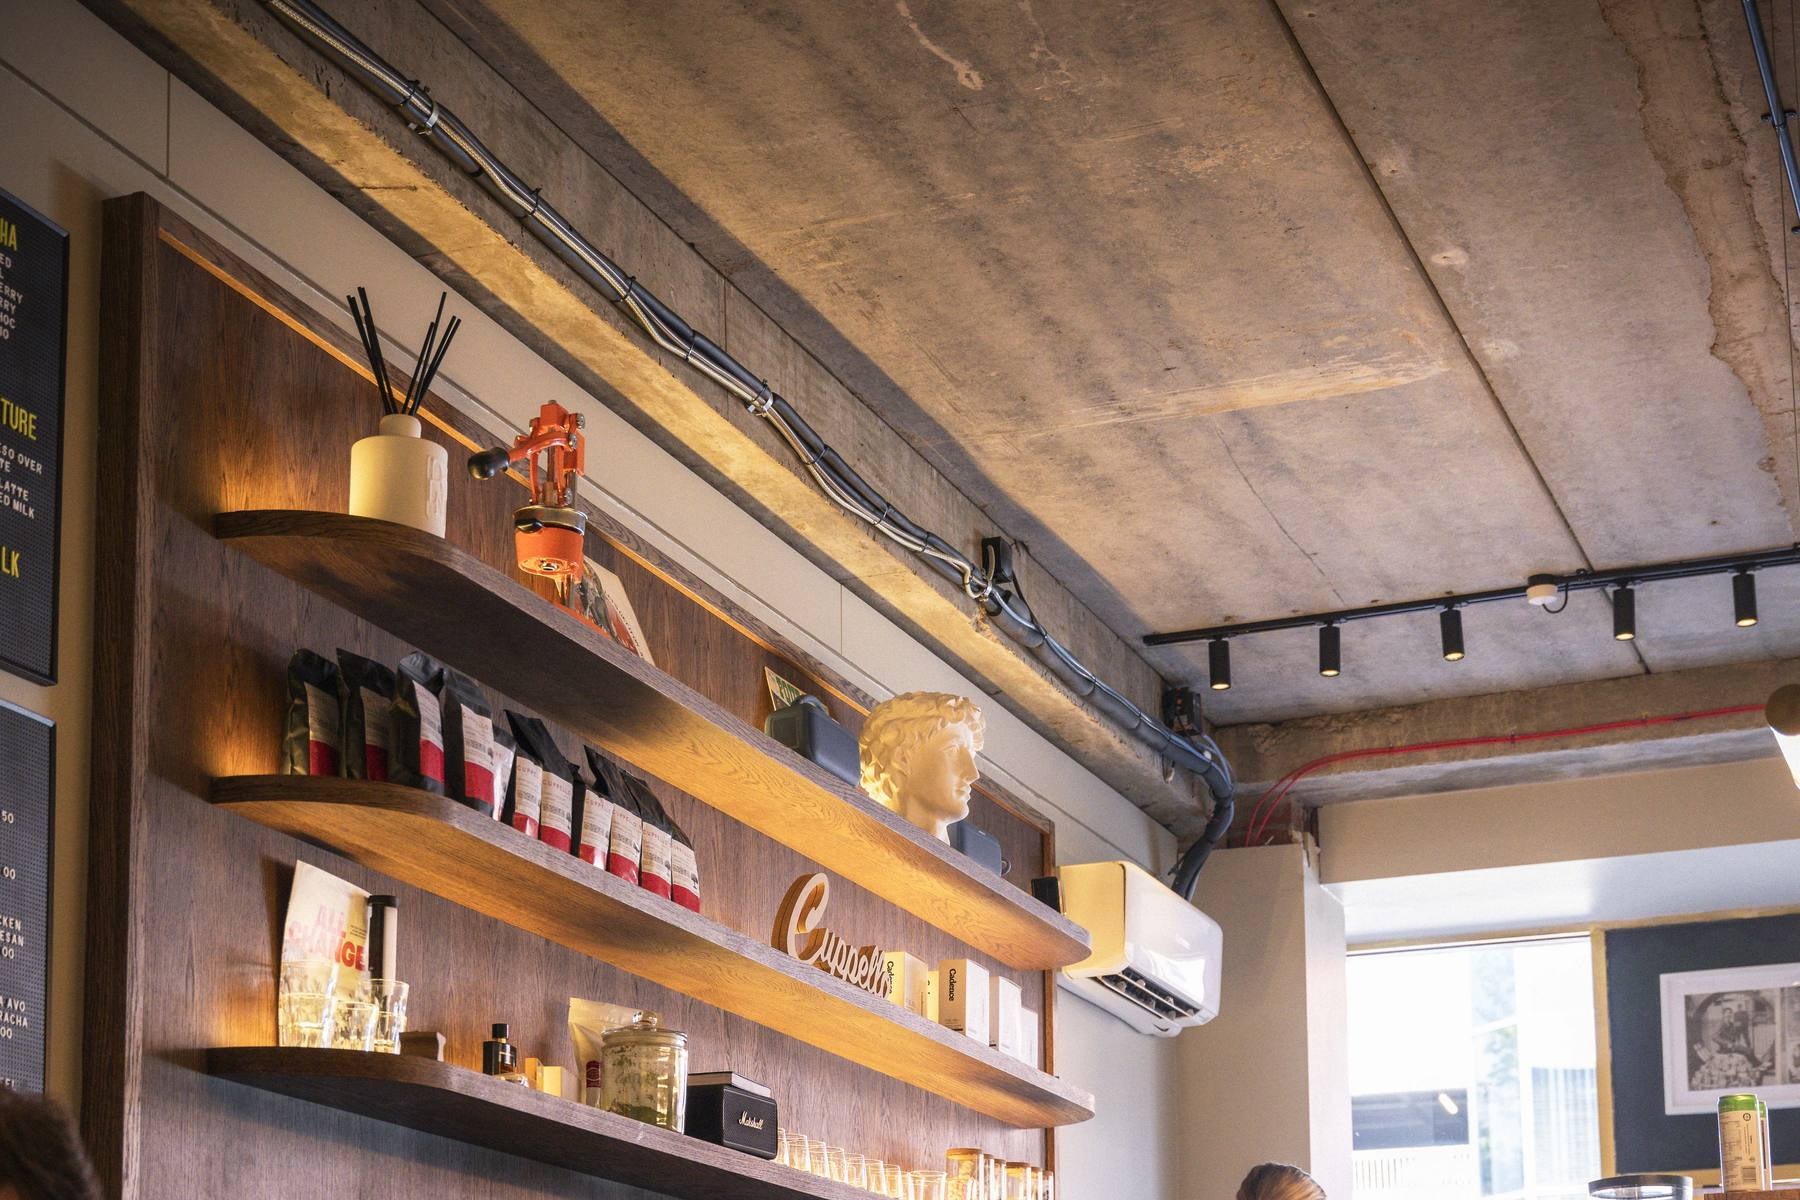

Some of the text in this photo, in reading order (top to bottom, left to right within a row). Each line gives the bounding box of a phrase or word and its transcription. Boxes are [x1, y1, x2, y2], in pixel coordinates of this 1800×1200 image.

[0, 397, 37, 441] TURE
[0, 442, 42, 475] SO OVER
[12, 498, 34, 519] MILK
[2, 545, 20, 578] LK
[1, 810, 14, 824] 50
[0, 915, 21, 931] KEN
[773, 872, 889, 999] Cuppello
[949, 968, 957, 1001] Cadence
[7, 998, 25, 1012] AVO
[738, 1110, 764, 1130] Marshall
